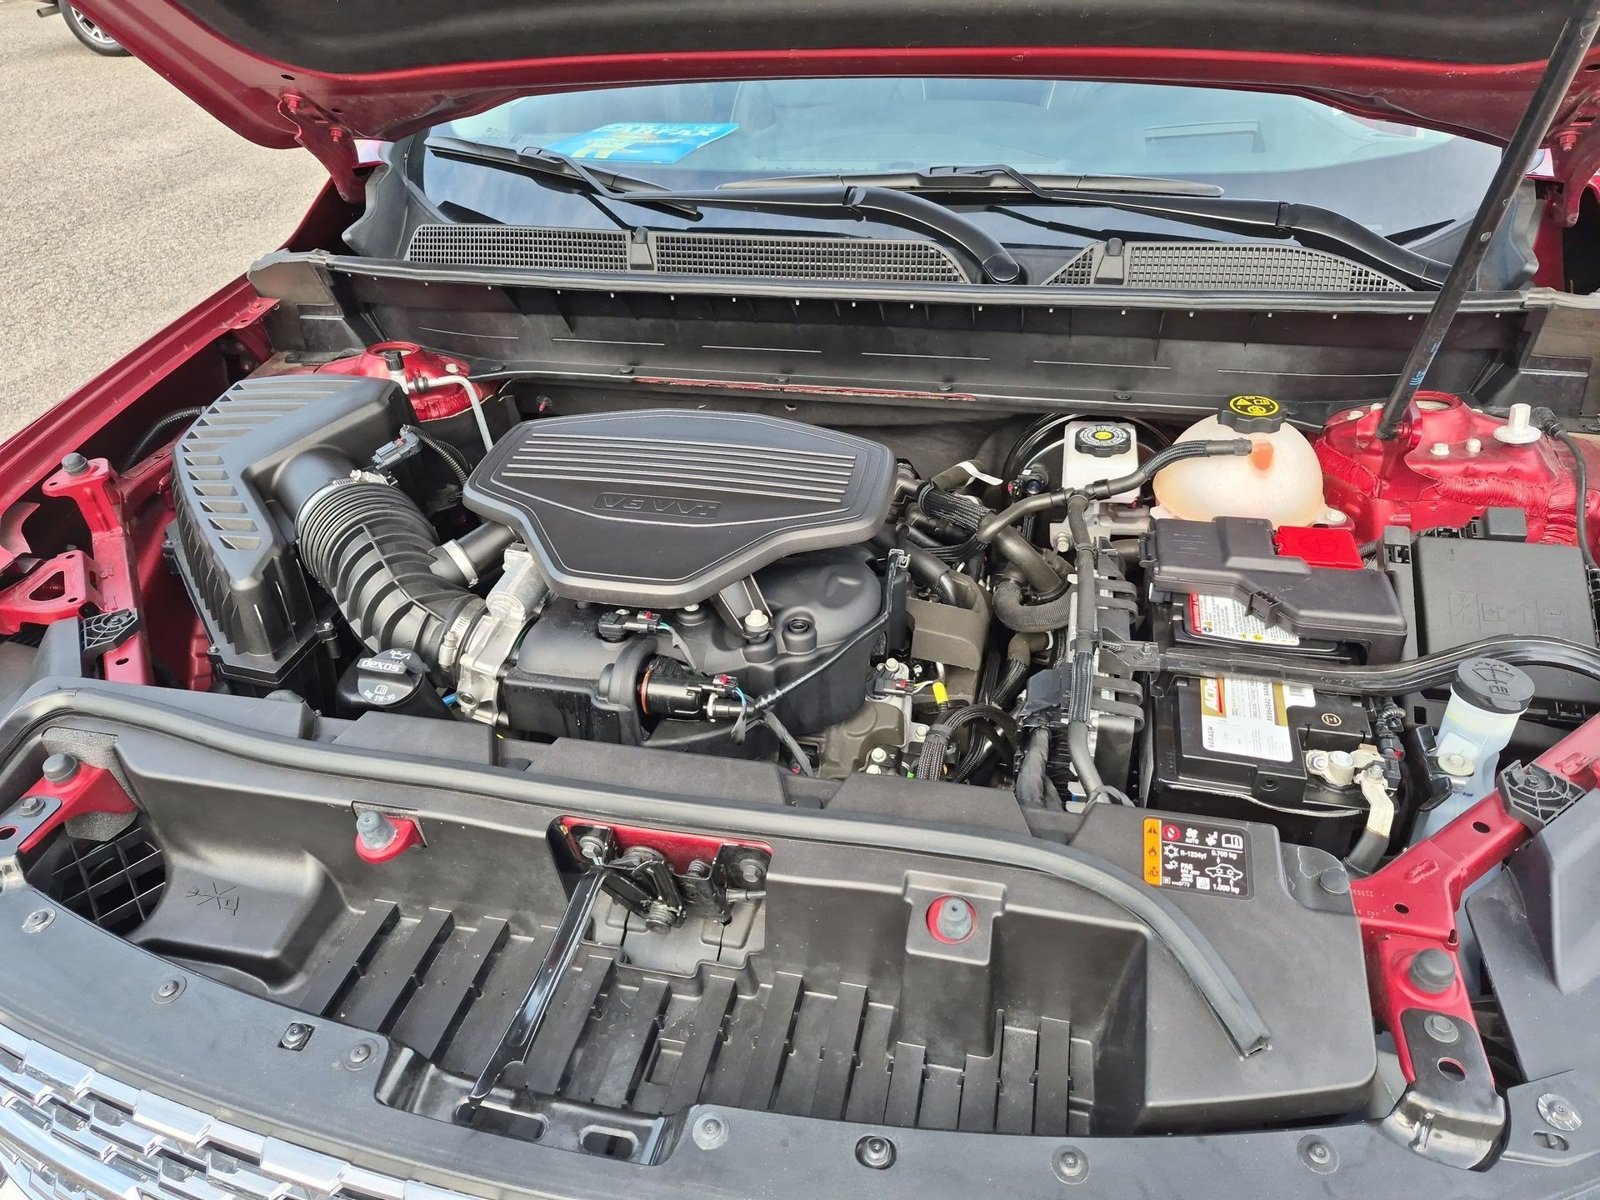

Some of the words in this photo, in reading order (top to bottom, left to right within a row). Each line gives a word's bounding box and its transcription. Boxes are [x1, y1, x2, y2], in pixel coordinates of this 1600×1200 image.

[361, 658, 400, 672] dexos
[1185, 837, 1200, 845] AUTO
[1180, 849, 1207, 860] R-1234yf
[1228, 852, 1238, 861] kg
[1230, 886, 1240, 895] kg
